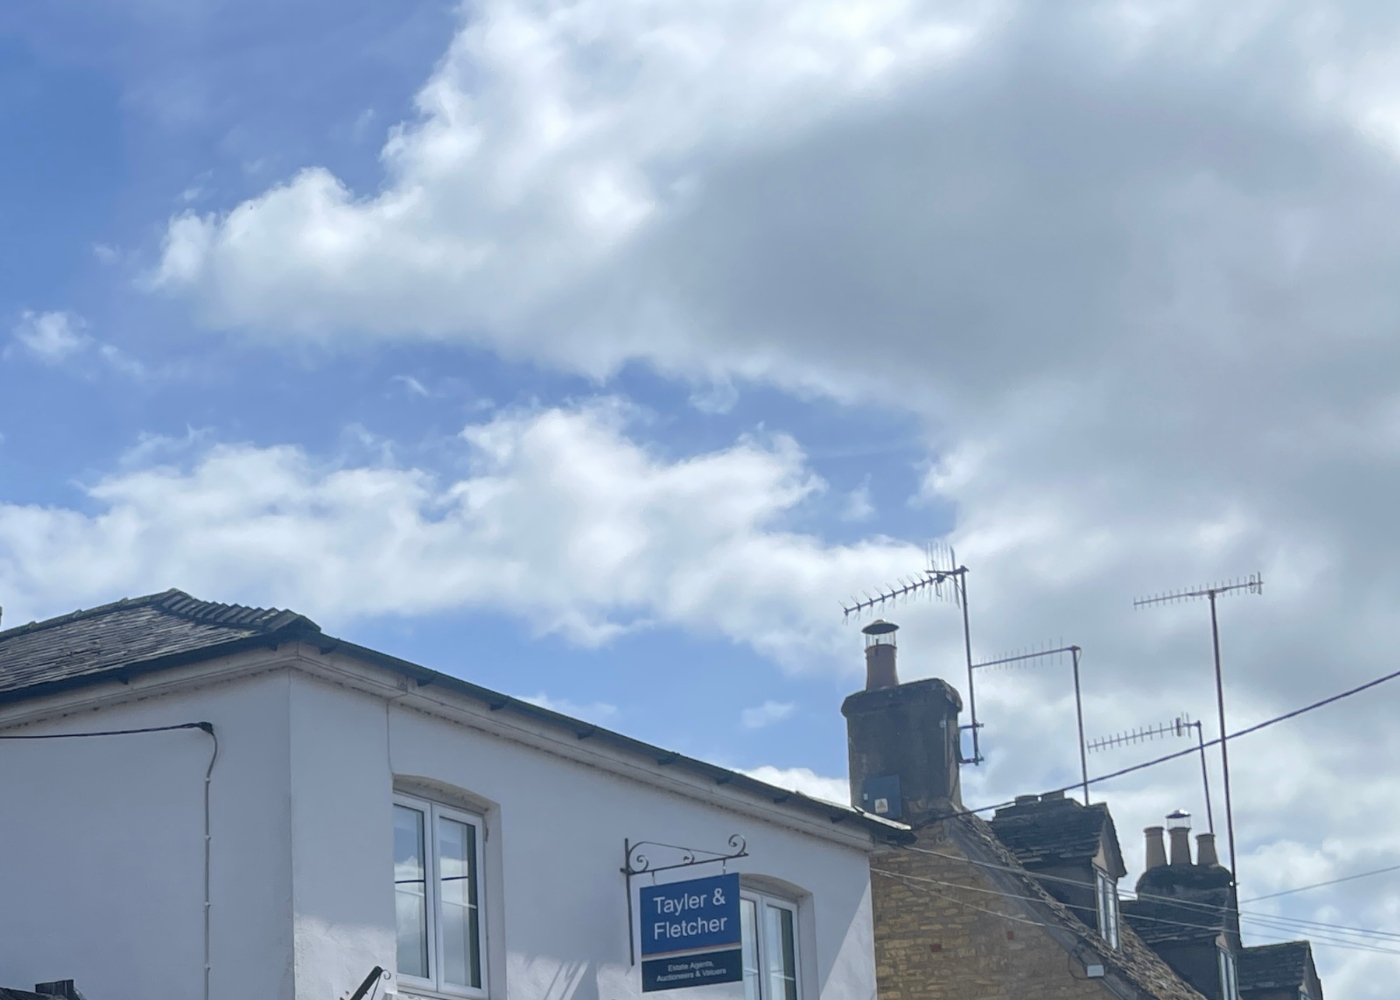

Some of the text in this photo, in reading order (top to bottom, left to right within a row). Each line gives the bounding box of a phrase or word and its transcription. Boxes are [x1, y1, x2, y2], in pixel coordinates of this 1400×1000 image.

[653, 888, 726, 916] Tayler &
[654, 917, 728, 940] Fletcher
[656, 972, 695, 982] Auctioneers
[702, 968, 727, 976] Valuers
[668, 963, 689, 972] Estate
